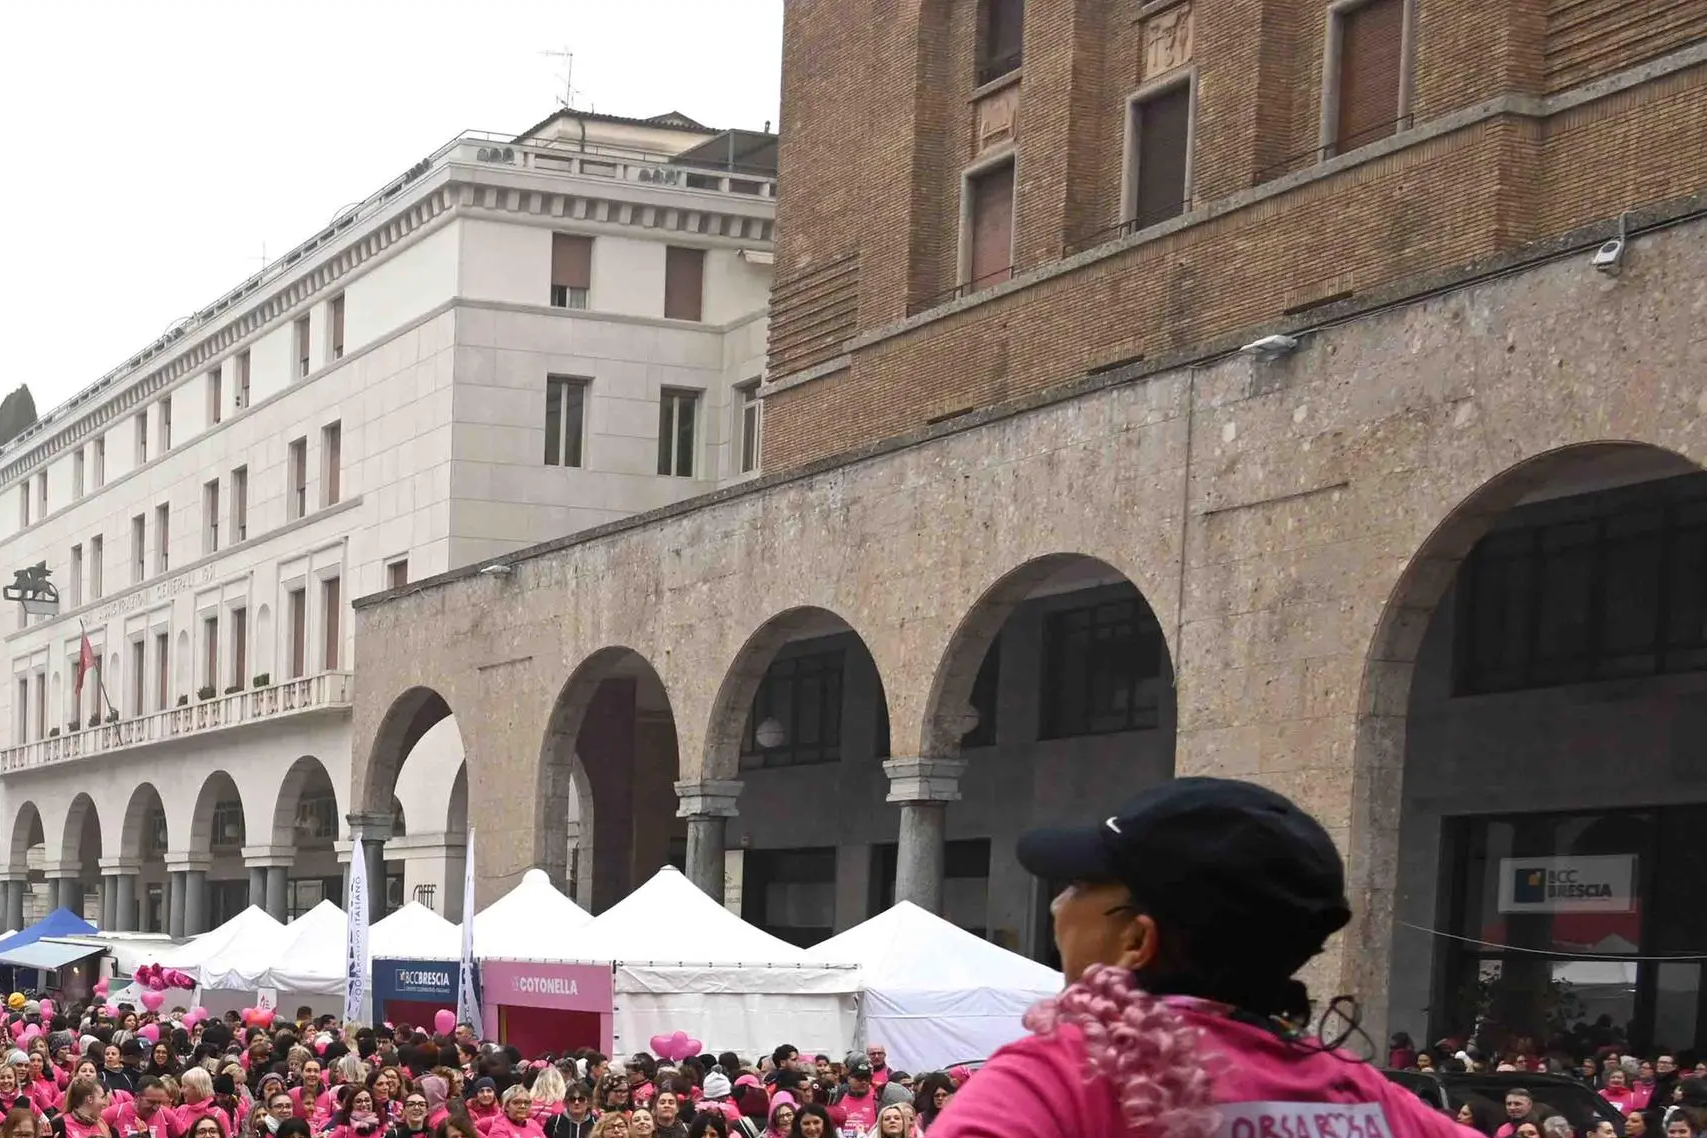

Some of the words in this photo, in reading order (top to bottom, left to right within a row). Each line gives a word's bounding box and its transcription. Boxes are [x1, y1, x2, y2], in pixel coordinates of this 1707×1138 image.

[1548, 870, 1579, 883] BCC
[1548, 884, 1612, 897] BRESCIA
[521, 977, 578, 995] COTONELLA
